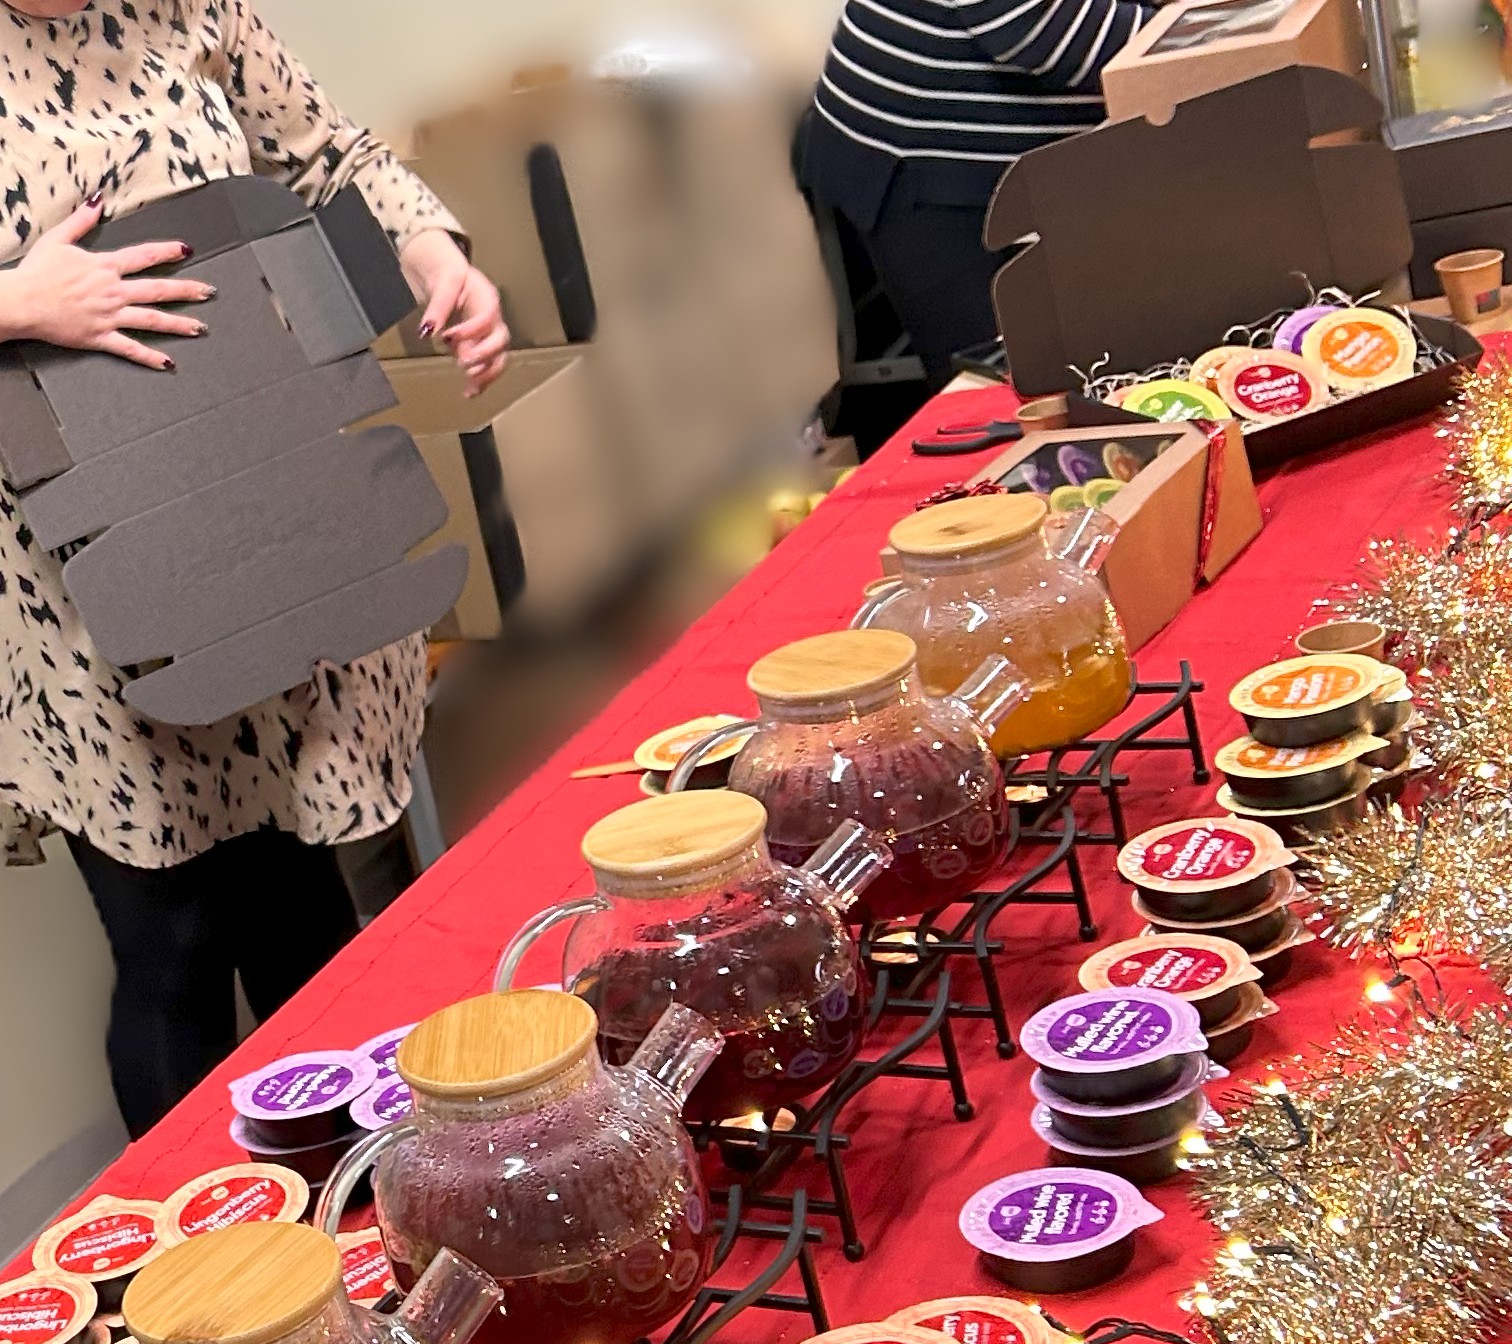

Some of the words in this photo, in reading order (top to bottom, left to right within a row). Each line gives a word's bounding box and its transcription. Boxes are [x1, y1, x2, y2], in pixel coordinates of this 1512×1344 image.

[1162, 829, 1211, 878] Cranberry
[1185, 838, 1224, 874] Orange
[1131, 950, 1183, 988] ranberry
[185, 1179, 272, 1233] Lingonberry
[58, 1232, 157, 1264] Lingonberry
[73, 1226, 139, 1250] Hibiscus
